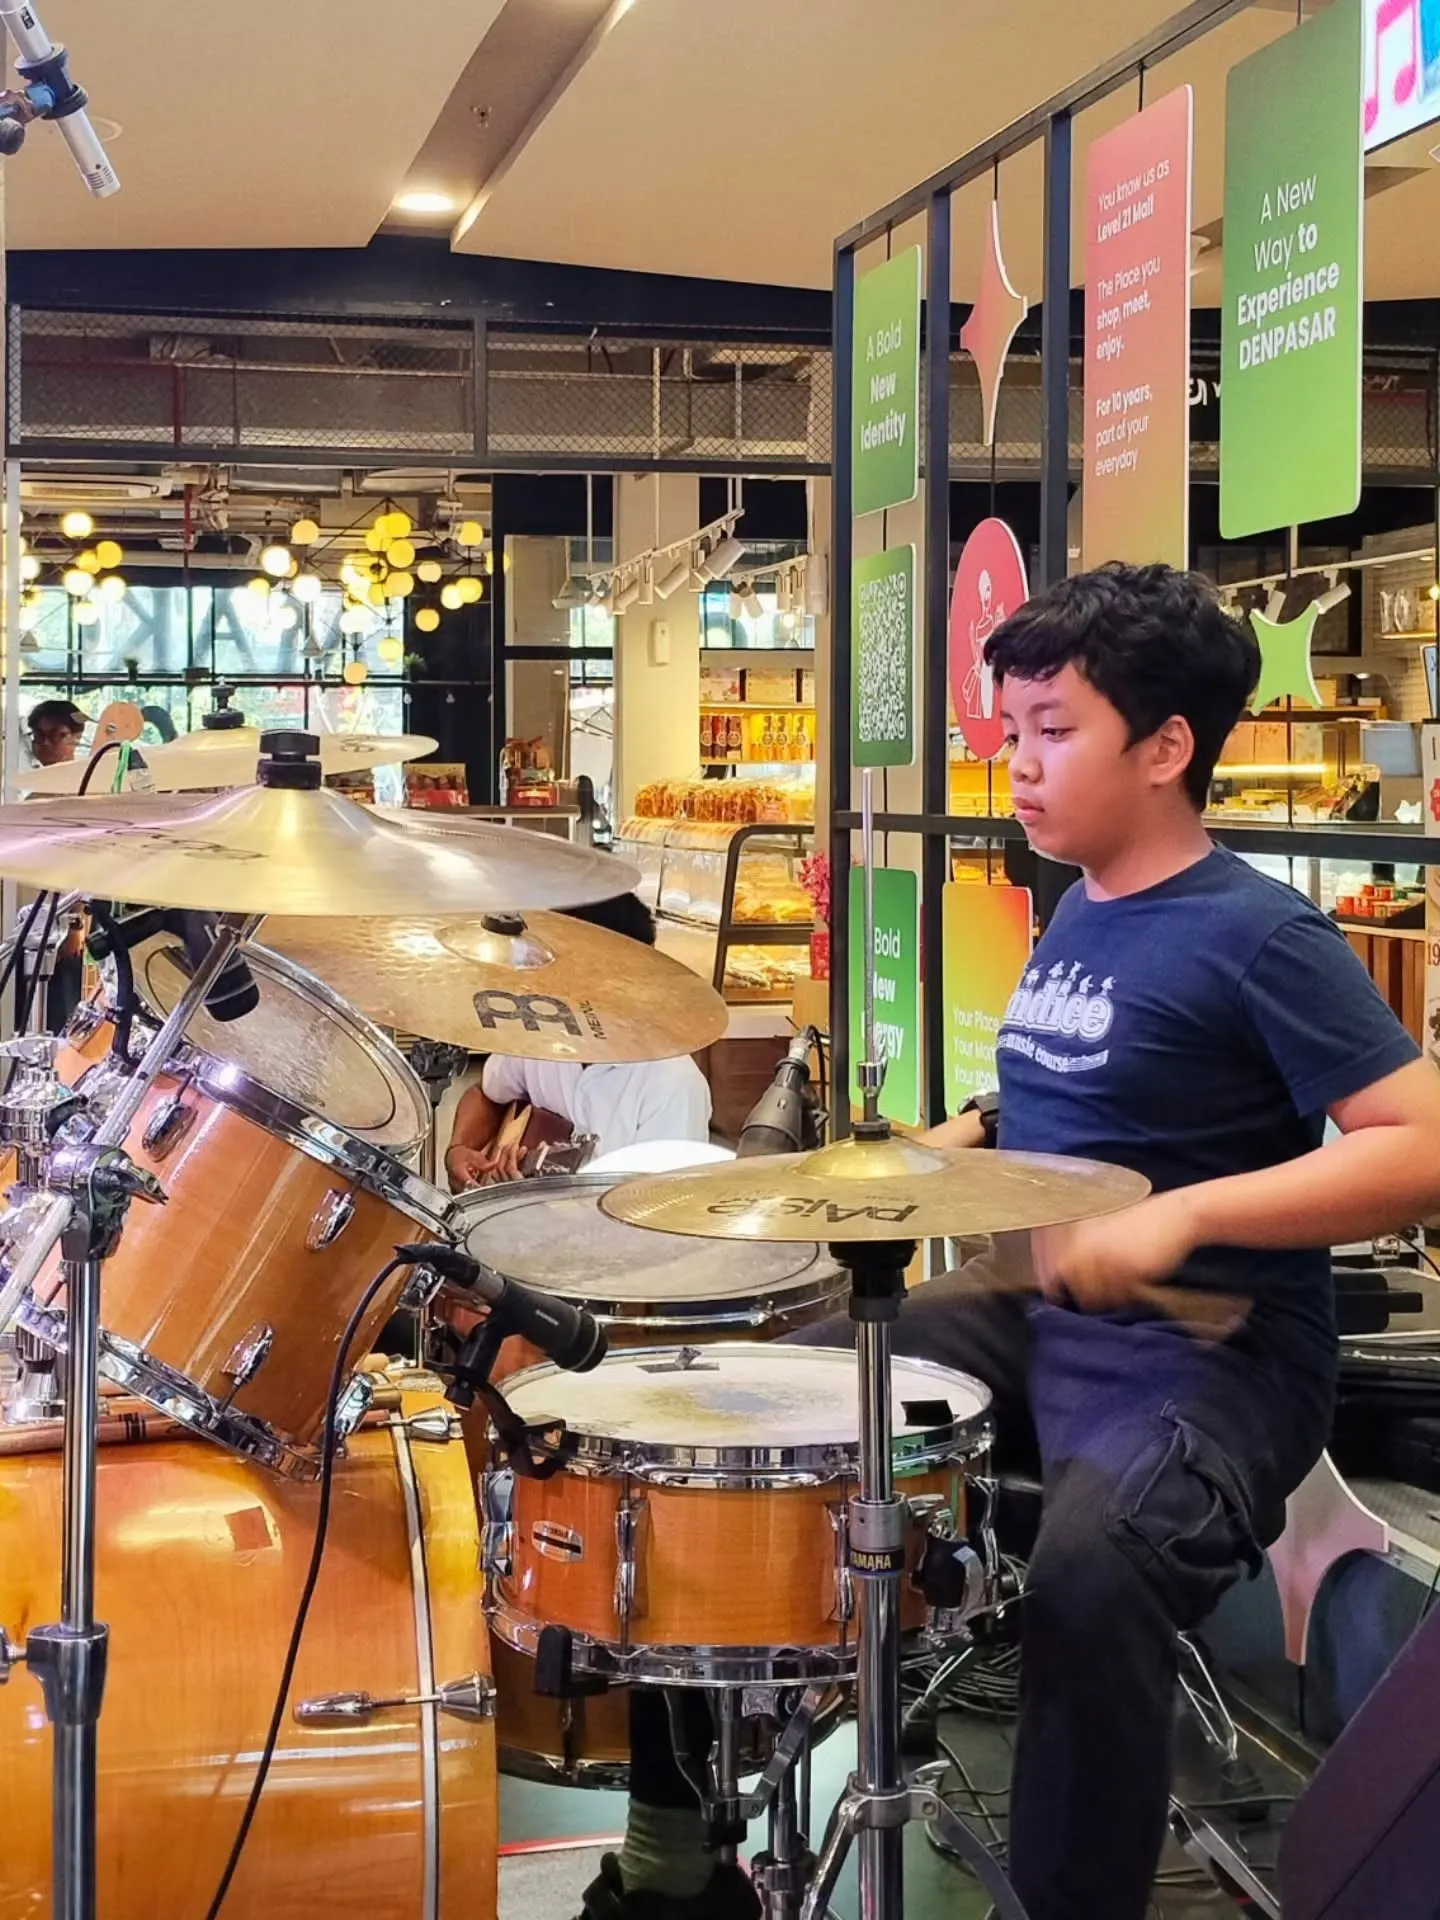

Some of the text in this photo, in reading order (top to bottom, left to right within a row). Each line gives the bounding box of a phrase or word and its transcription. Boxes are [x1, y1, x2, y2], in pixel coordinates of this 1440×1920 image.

[1098, 159, 1170, 213] You know us as
[1259, 175, 1317, 225] A New
[1097, 191, 1154, 243] Level 21 Mall
[1254, 222, 1318, 273] Way to
[1097, 255, 1160, 302] The Place you
[1237, 262, 1340, 329] Experience
[1096, 289, 1151, 331] shop, meet,
[866, 319, 902, 363] A Bold
[1096, 334, 1125, 362] enjoy.
[1239, 305, 1336, 371] DENPASAR
[870, 371, 896, 405] New
[1095, 383, 1152, 419] For 10 years,
[861, 408, 906, 454] Identity
[1096, 415, 1149, 453] part of your
[1095, 447, 1138, 477] everyday
[873, 926, 901, 960] Bold
[953, 1004, 974, 1029] Your
[953, 1035, 974, 1059] Your
[953, 1063, 974, 1087] Your
